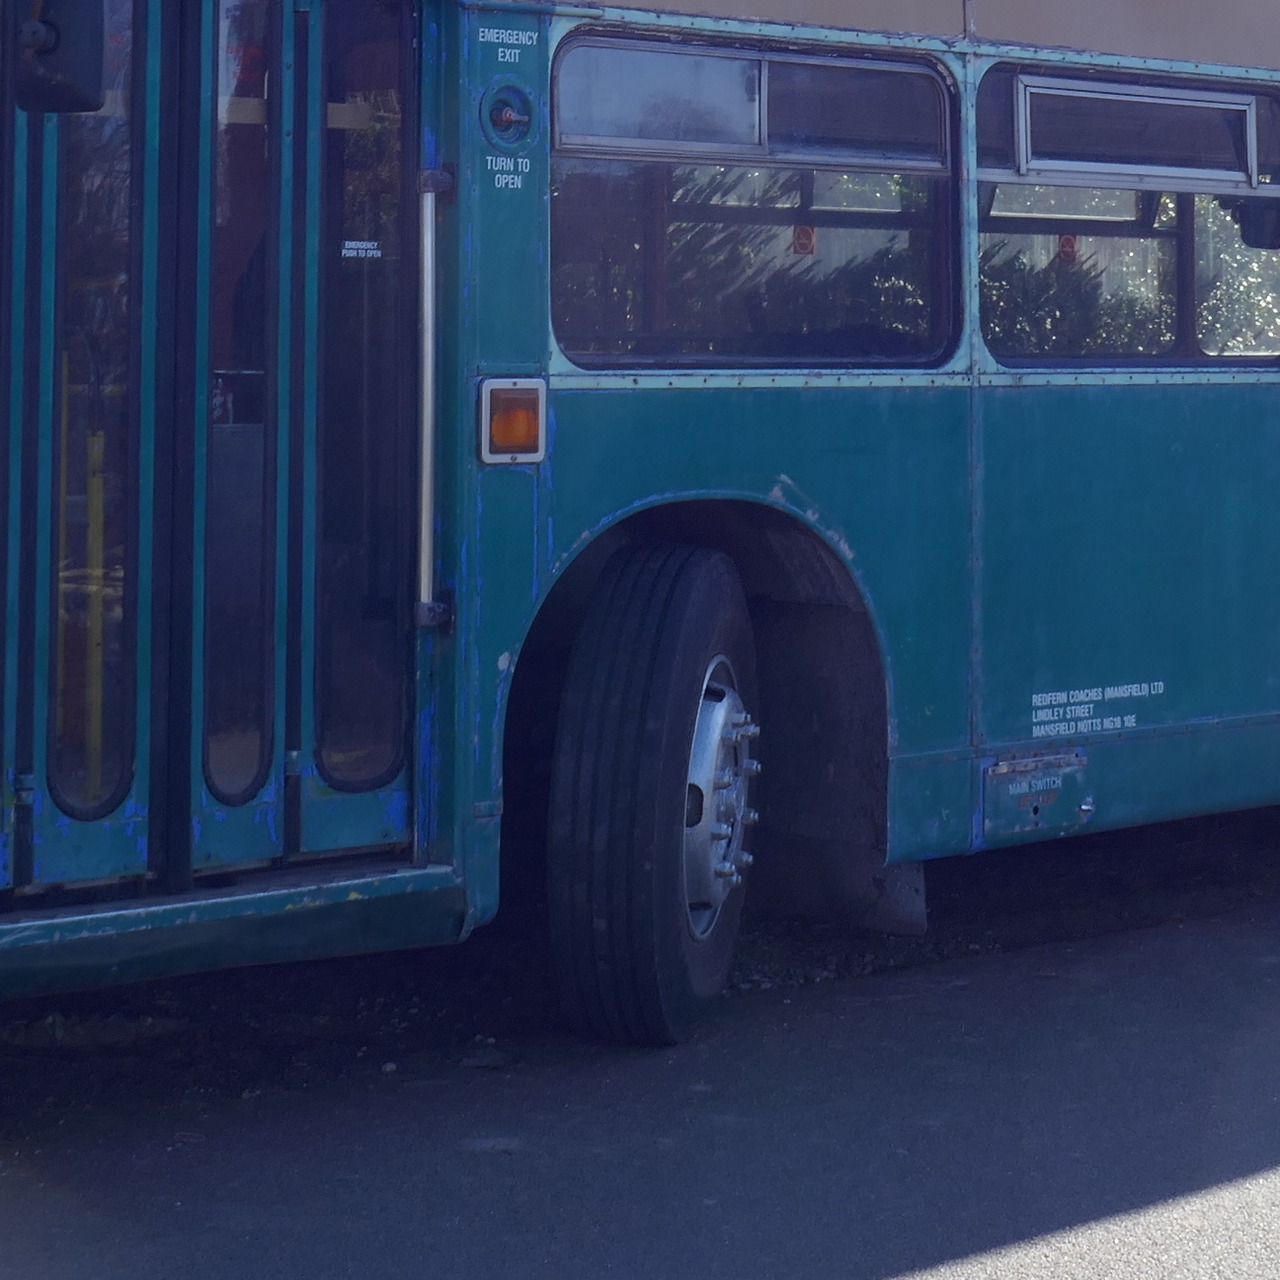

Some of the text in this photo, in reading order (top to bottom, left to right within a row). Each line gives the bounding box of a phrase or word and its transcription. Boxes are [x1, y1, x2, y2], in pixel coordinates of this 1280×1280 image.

[479, 28, 539, 46] EMERGENCY
[497, 48, 521, 63] EXIT
[486, 156, 530, 173] TURN TO
[495, 173, 522, 189] OPEN
[366, 249, 382, 258] OPEN
[1032, 681, 1164, 706] REDFERN COACHES (MANSFIELD) LTD
[1032, 704, 1095, 722] LINDLEY STREET
[1032, 721, 1076, 737] MANSFIELD
[1077, 718, 1102, 733] NOTTS
[1008, 776, 1063, 796] MAIN SWITCH
